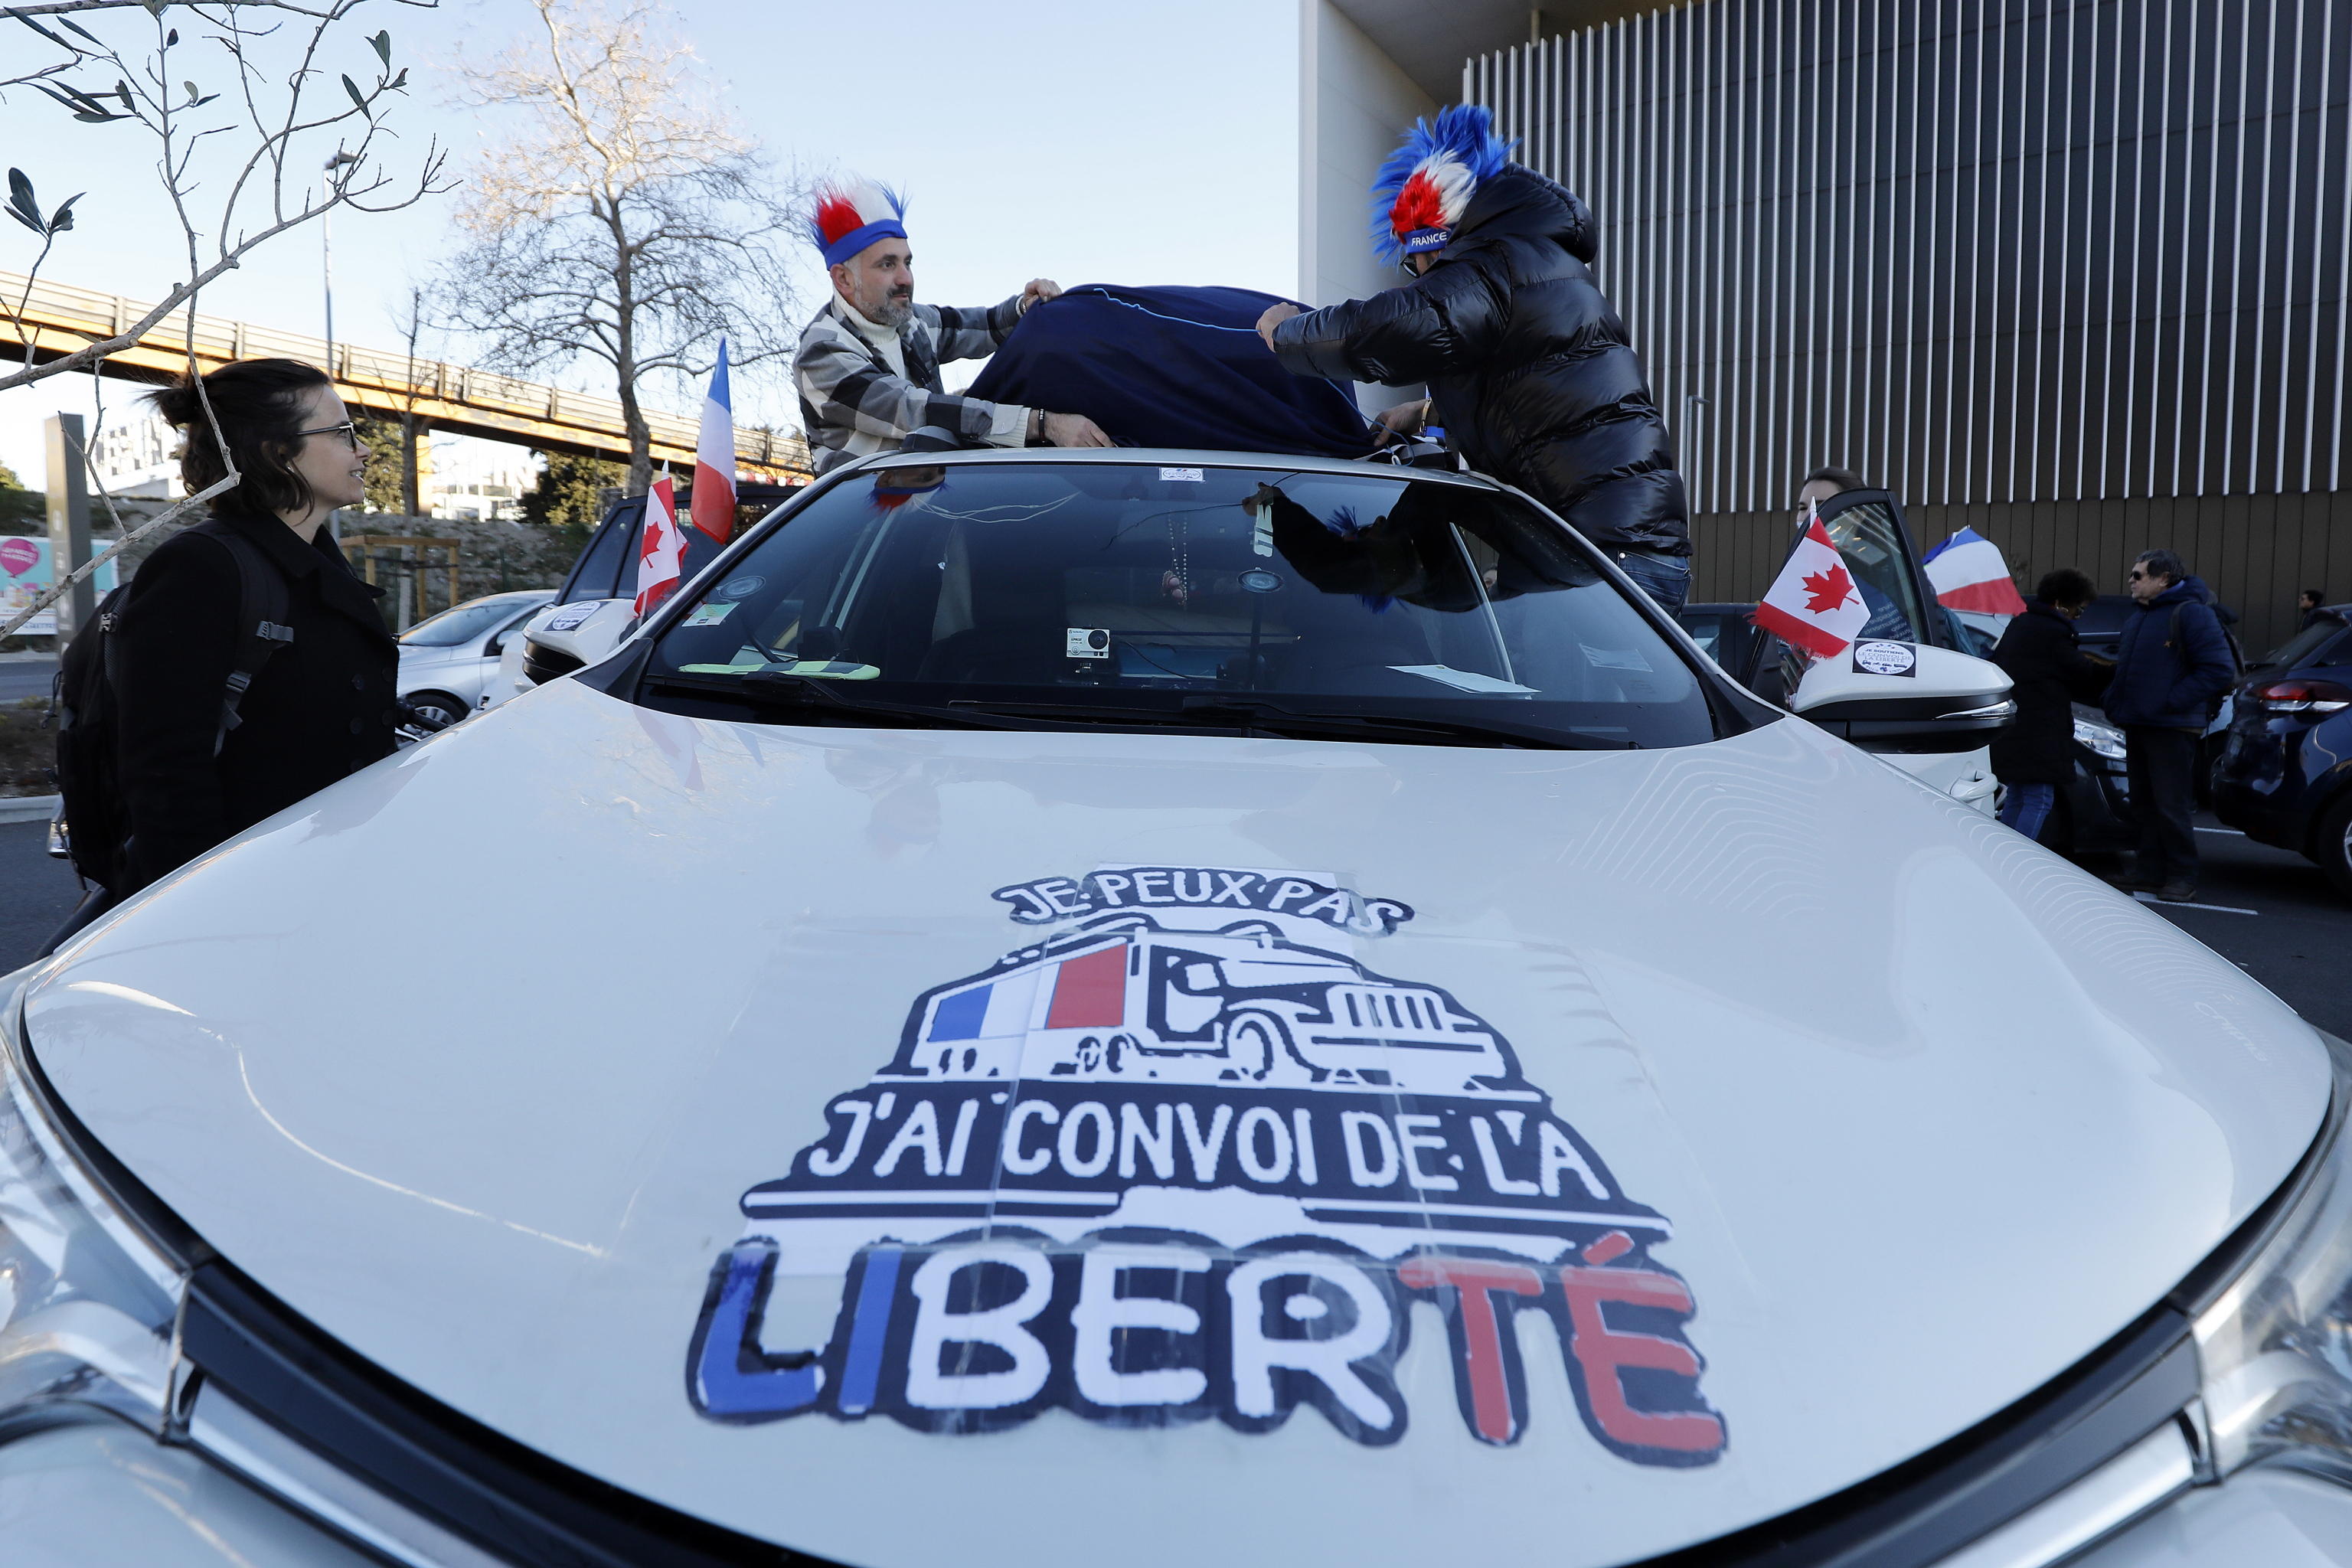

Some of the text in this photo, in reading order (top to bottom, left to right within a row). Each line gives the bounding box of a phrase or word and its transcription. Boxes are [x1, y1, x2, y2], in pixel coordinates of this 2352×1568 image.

[1411, 231, 1447, 247] FRANCE
[1001, 870, 1404, 934] JE PEUX PAS
[808, 1092, 1610, 1200] J'AI CONVOI DE L'A
[693, 1231, 1726, 1455] LIBERTÉ
